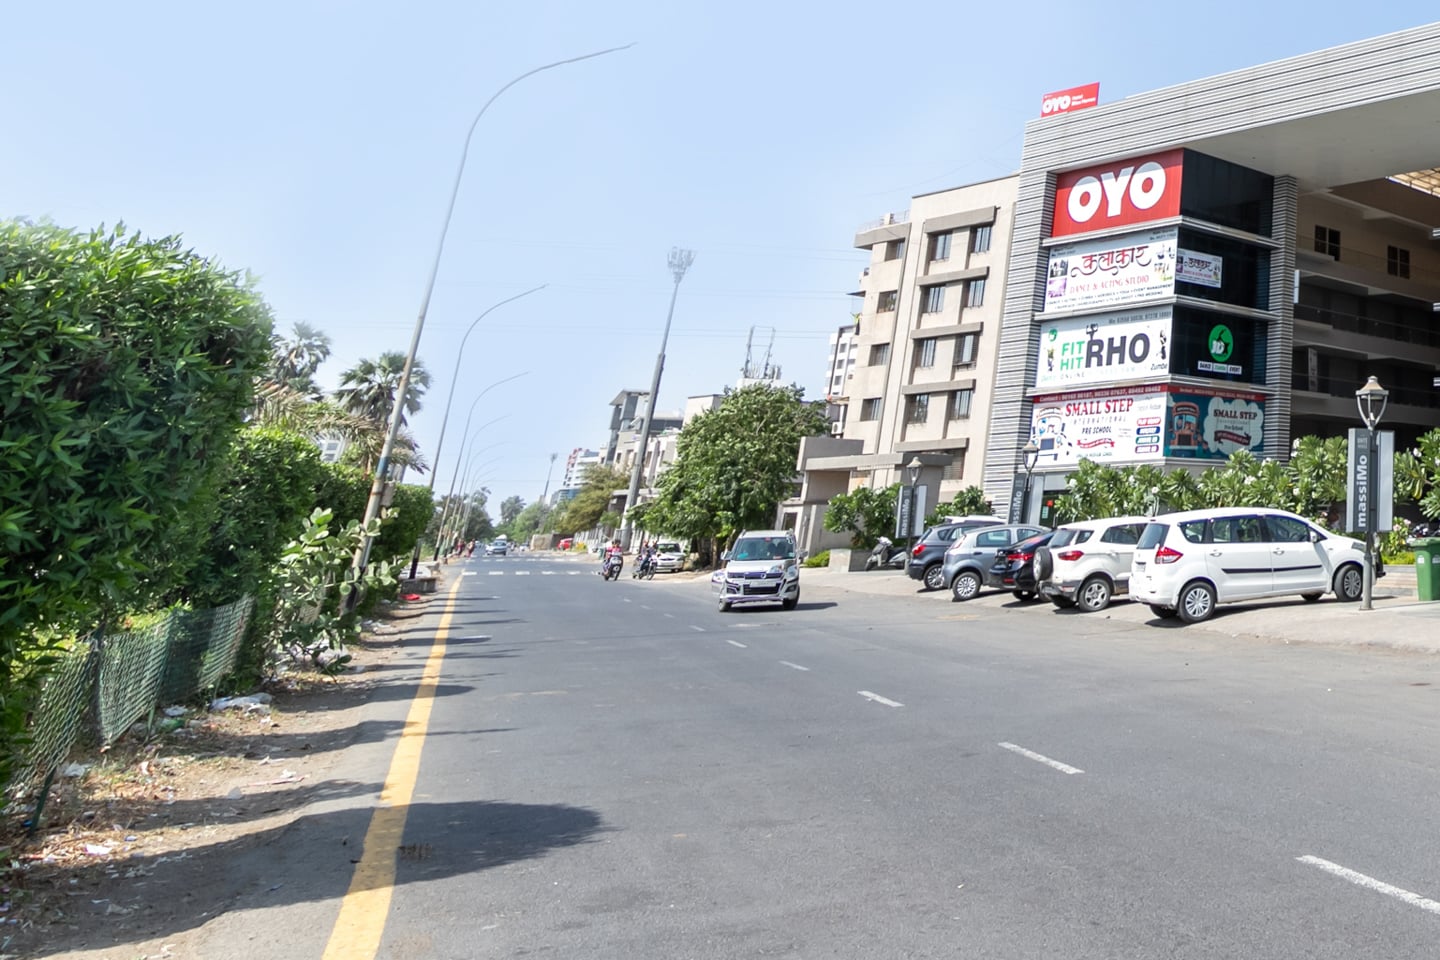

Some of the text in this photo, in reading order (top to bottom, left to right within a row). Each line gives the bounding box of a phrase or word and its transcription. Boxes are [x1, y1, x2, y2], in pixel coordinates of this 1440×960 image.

[1042, 95, 1070, 113] OYO
[1067, 161, 1166, 223] OYO
[1070, 284, 1090, 294] DANCE
[1101, 279, 1123, 290] ACTING
[1125, 275, 1150, 286] STUDIO
[1062, 341, 1085, 356] FIT
[1085, 333, 1150, 368] RHO
[1060, 357, 1084, 371] HIT
[1065, 397, 1134, 416] SMALL STEP
[1213, 409, 1258, 420] SMALL STEP
[1082, 427, 1092, 435] PRE
[1093, 426, 1112, 434] SCHOOL
[1356, 455, 1367, 527] massiMo
